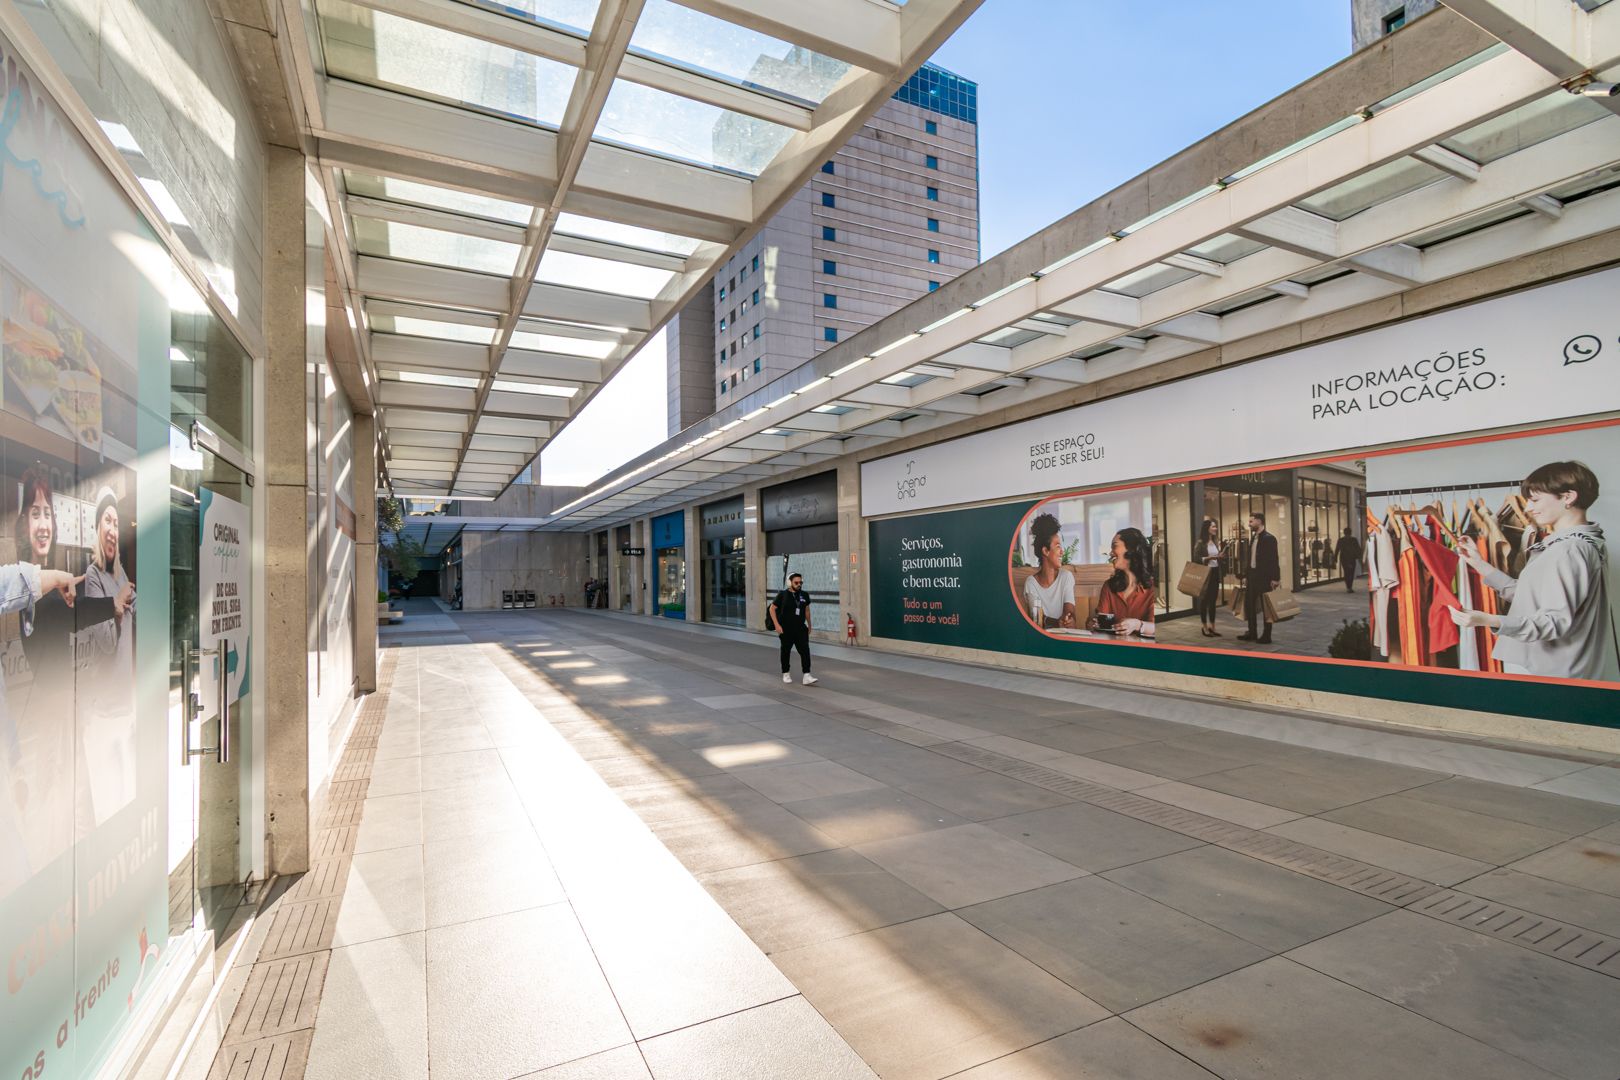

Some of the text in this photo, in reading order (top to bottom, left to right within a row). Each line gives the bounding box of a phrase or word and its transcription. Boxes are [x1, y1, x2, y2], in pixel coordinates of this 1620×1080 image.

[1312, 348, 1486, 398] INFORMAÇÕES
[1312, 371, 1506, 419] PARA LOCAÇÃO:
[1030, 433, 1095, 457] ESSE ESPAÇO
[1030, 446, 1105, 471] PODE SER SEU!
[213, 522, 240, 544] ORIGINAL
[901, 535, 944, 551] Serviços,
[902, 552, 962, 573] gastronomia
[902, 574, 961, 588] e bem estar.
[903, 597, 920, 609] Tudo
[929, 601, 943, 609] um
[903, 612, 960, 625] passo de você!
[56, 1018, 69, 1049] a
[73, 956, 120, 1028] frente
